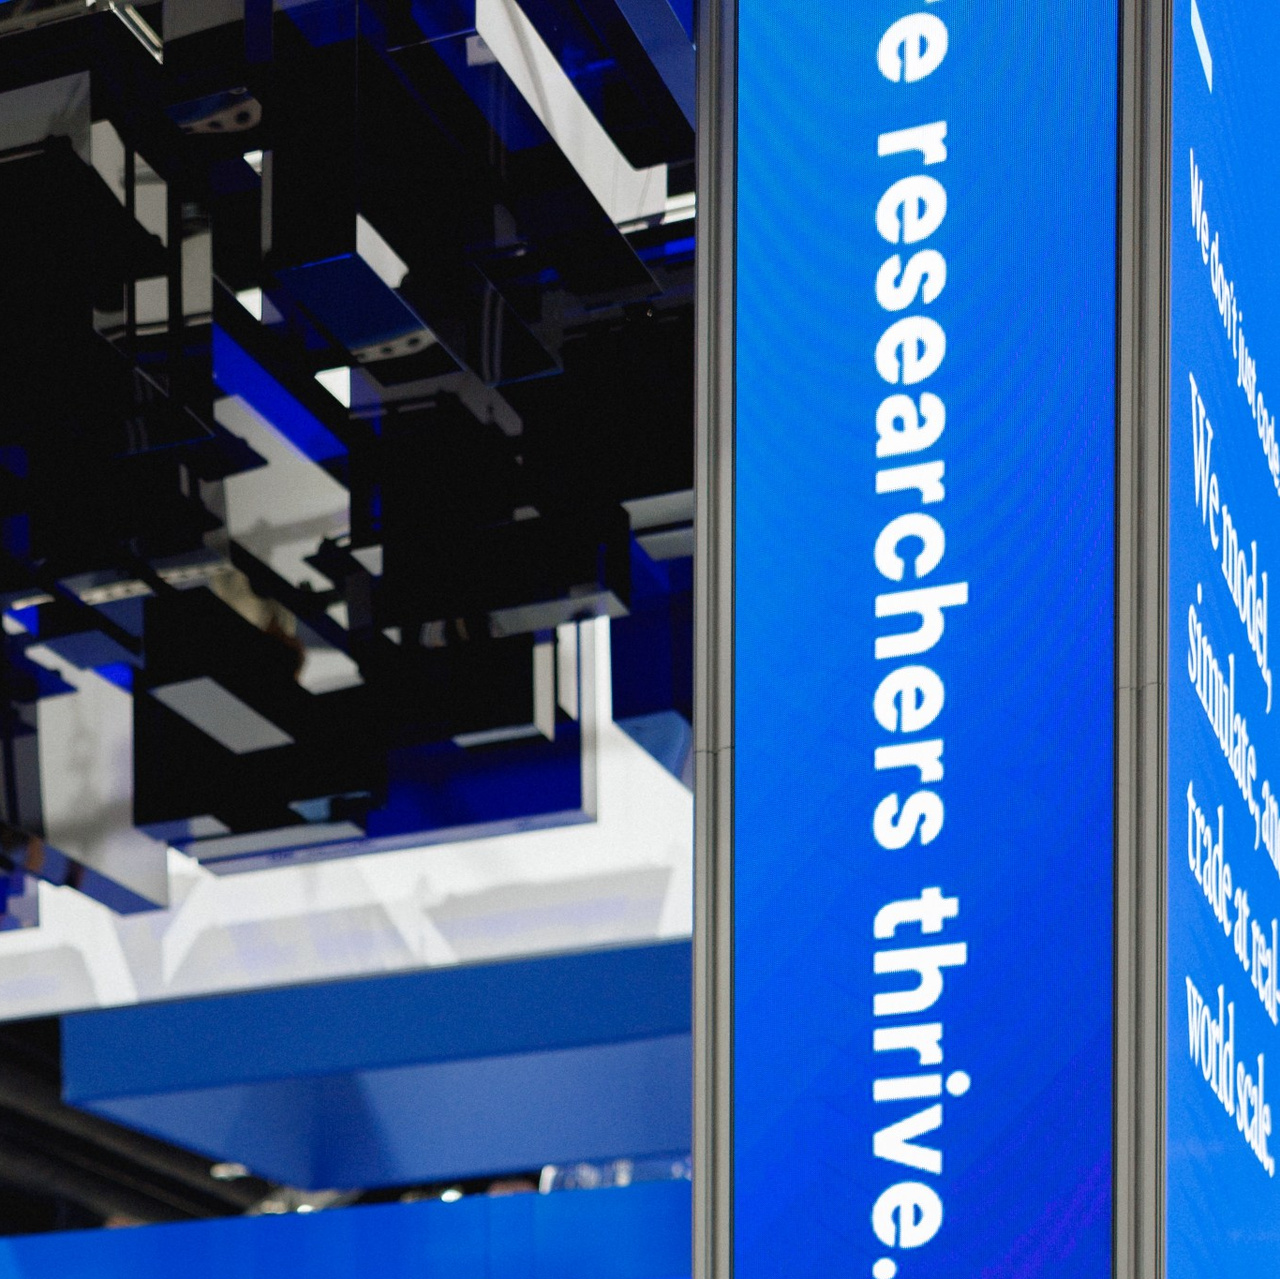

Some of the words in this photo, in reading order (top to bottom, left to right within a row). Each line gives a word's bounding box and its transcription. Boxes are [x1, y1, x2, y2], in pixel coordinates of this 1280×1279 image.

[875, 12, 950, 84] e
[1188, 147, 1210, 266] We
[1210, 231, 1238, 360] don't
[1237, 311, 1257, 420] just
[872, 119, 970, 851] researchers
[1188, 371, 1220, 551] We
[1221, 504, 1272, 715] model,
[1187, 582, 1261, 851] simulate,
[1261, 780, 1280, 880] an
[1186, 780, 1233, 938] trade
[1233, 887, 1251, 973] at
[1185, 975, 1236, 1118] world
[1236, 1053, 1275, 1178] scale.
